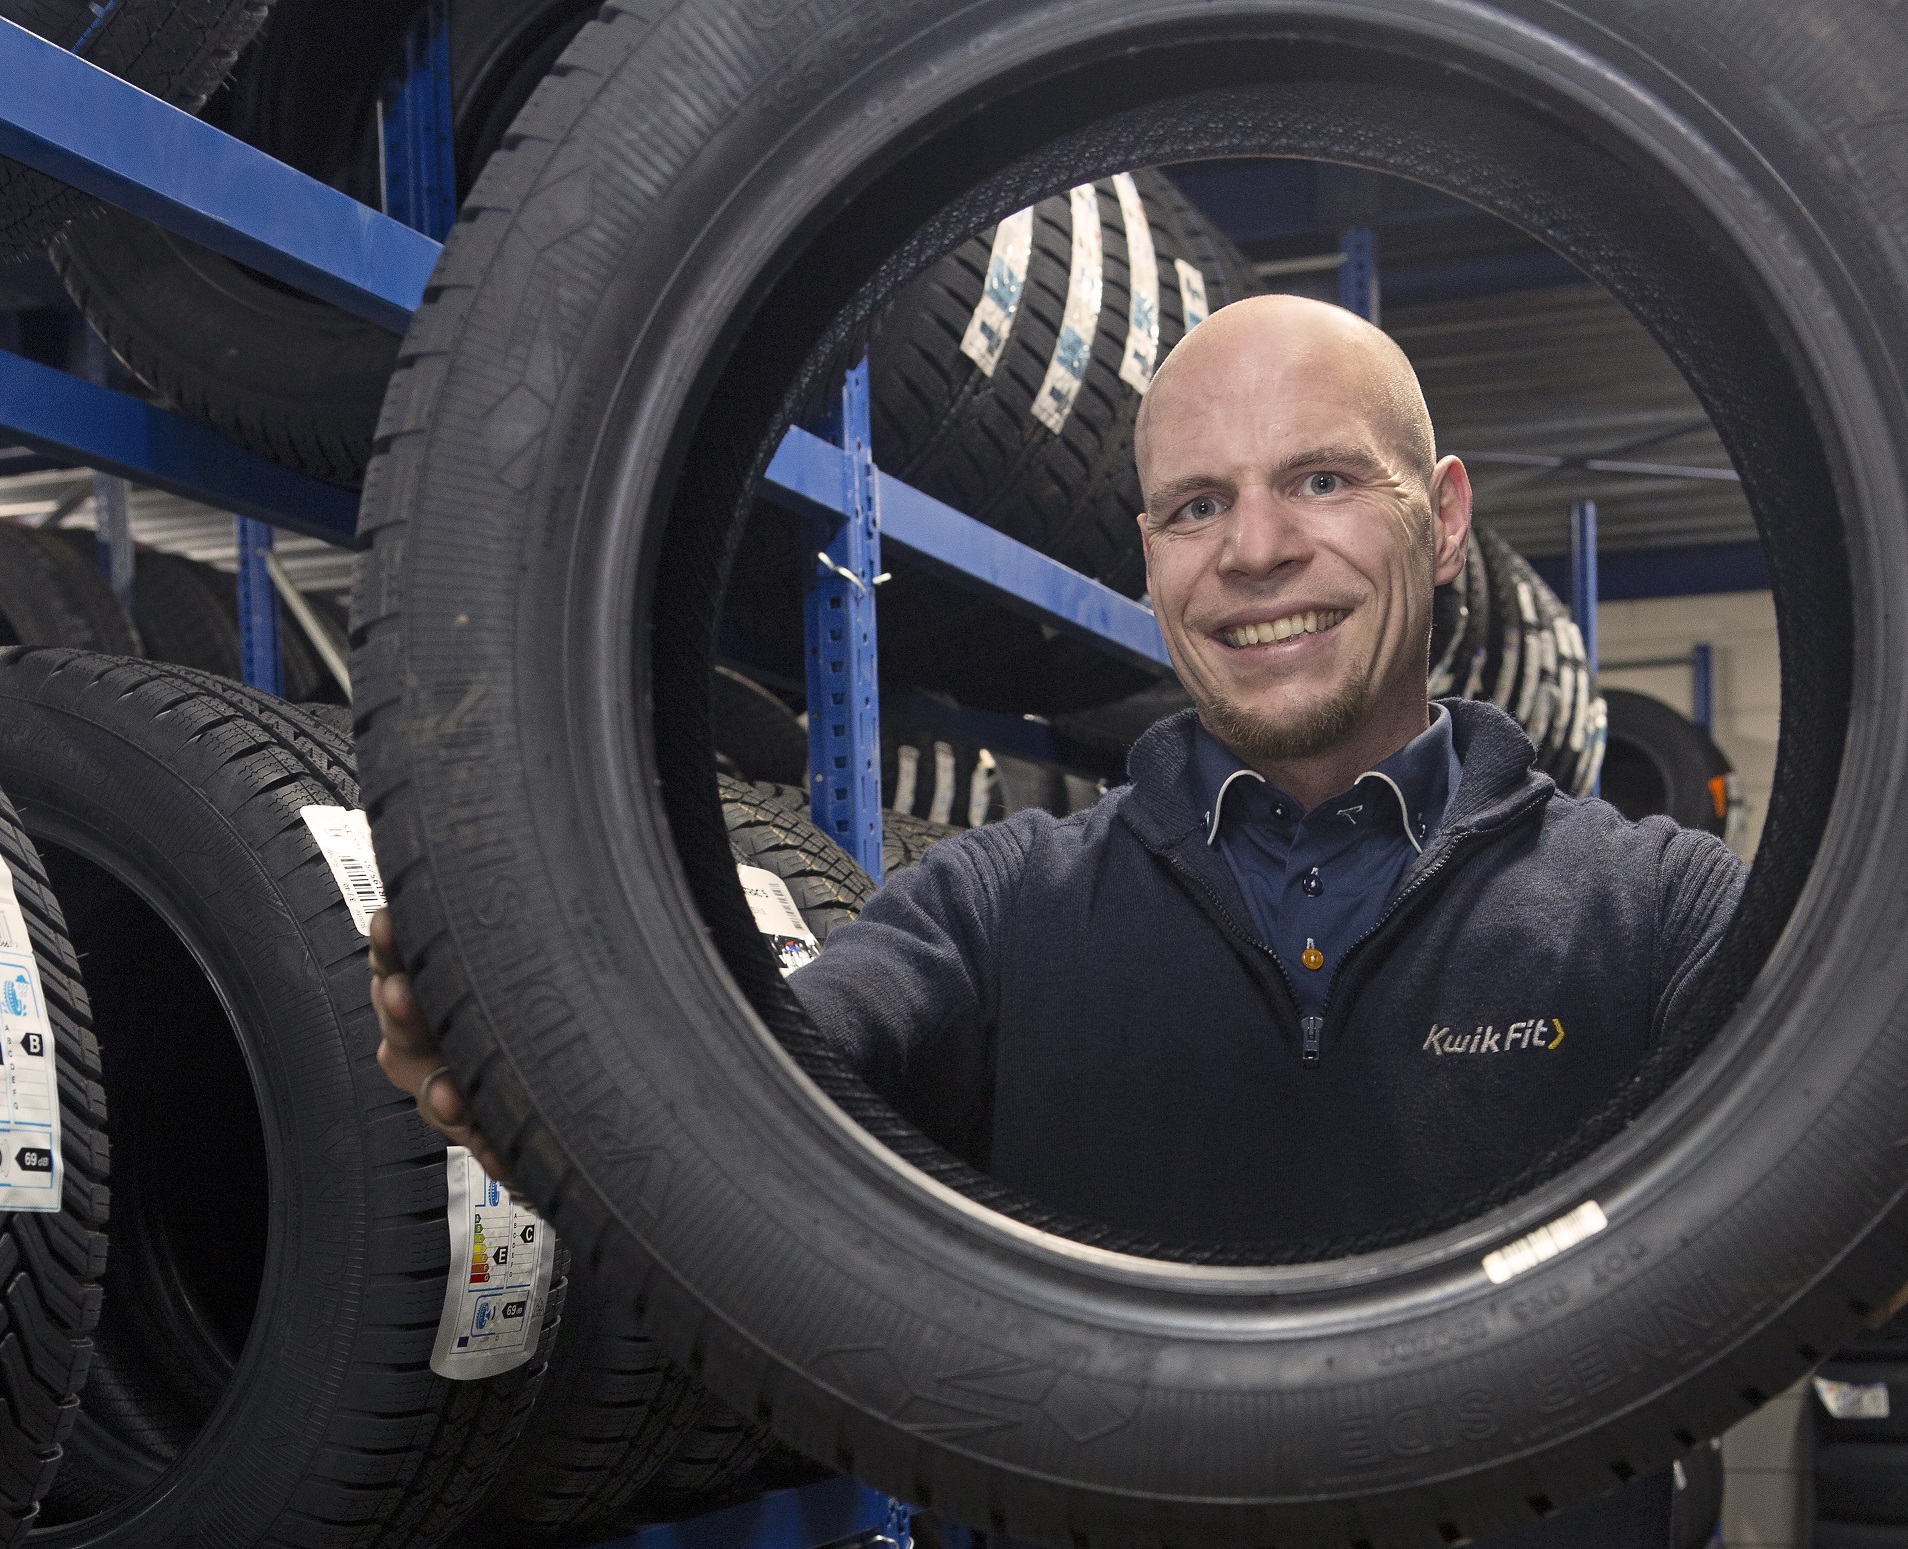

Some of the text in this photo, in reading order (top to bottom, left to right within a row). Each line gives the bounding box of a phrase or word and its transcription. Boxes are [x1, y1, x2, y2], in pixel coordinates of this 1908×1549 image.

[28, 1034, 41, 1053] B
[1422, 1018, 1548, 1056] Kwik Fit
[24, 1151, 49, 1167] 69 dB
[525, 1226, 534, 1241] C
[498, 1248, 507, 1263] E
[506, 1304, 517, 1316] 69
[1333, 1381, 1505, 1469] SIDE
